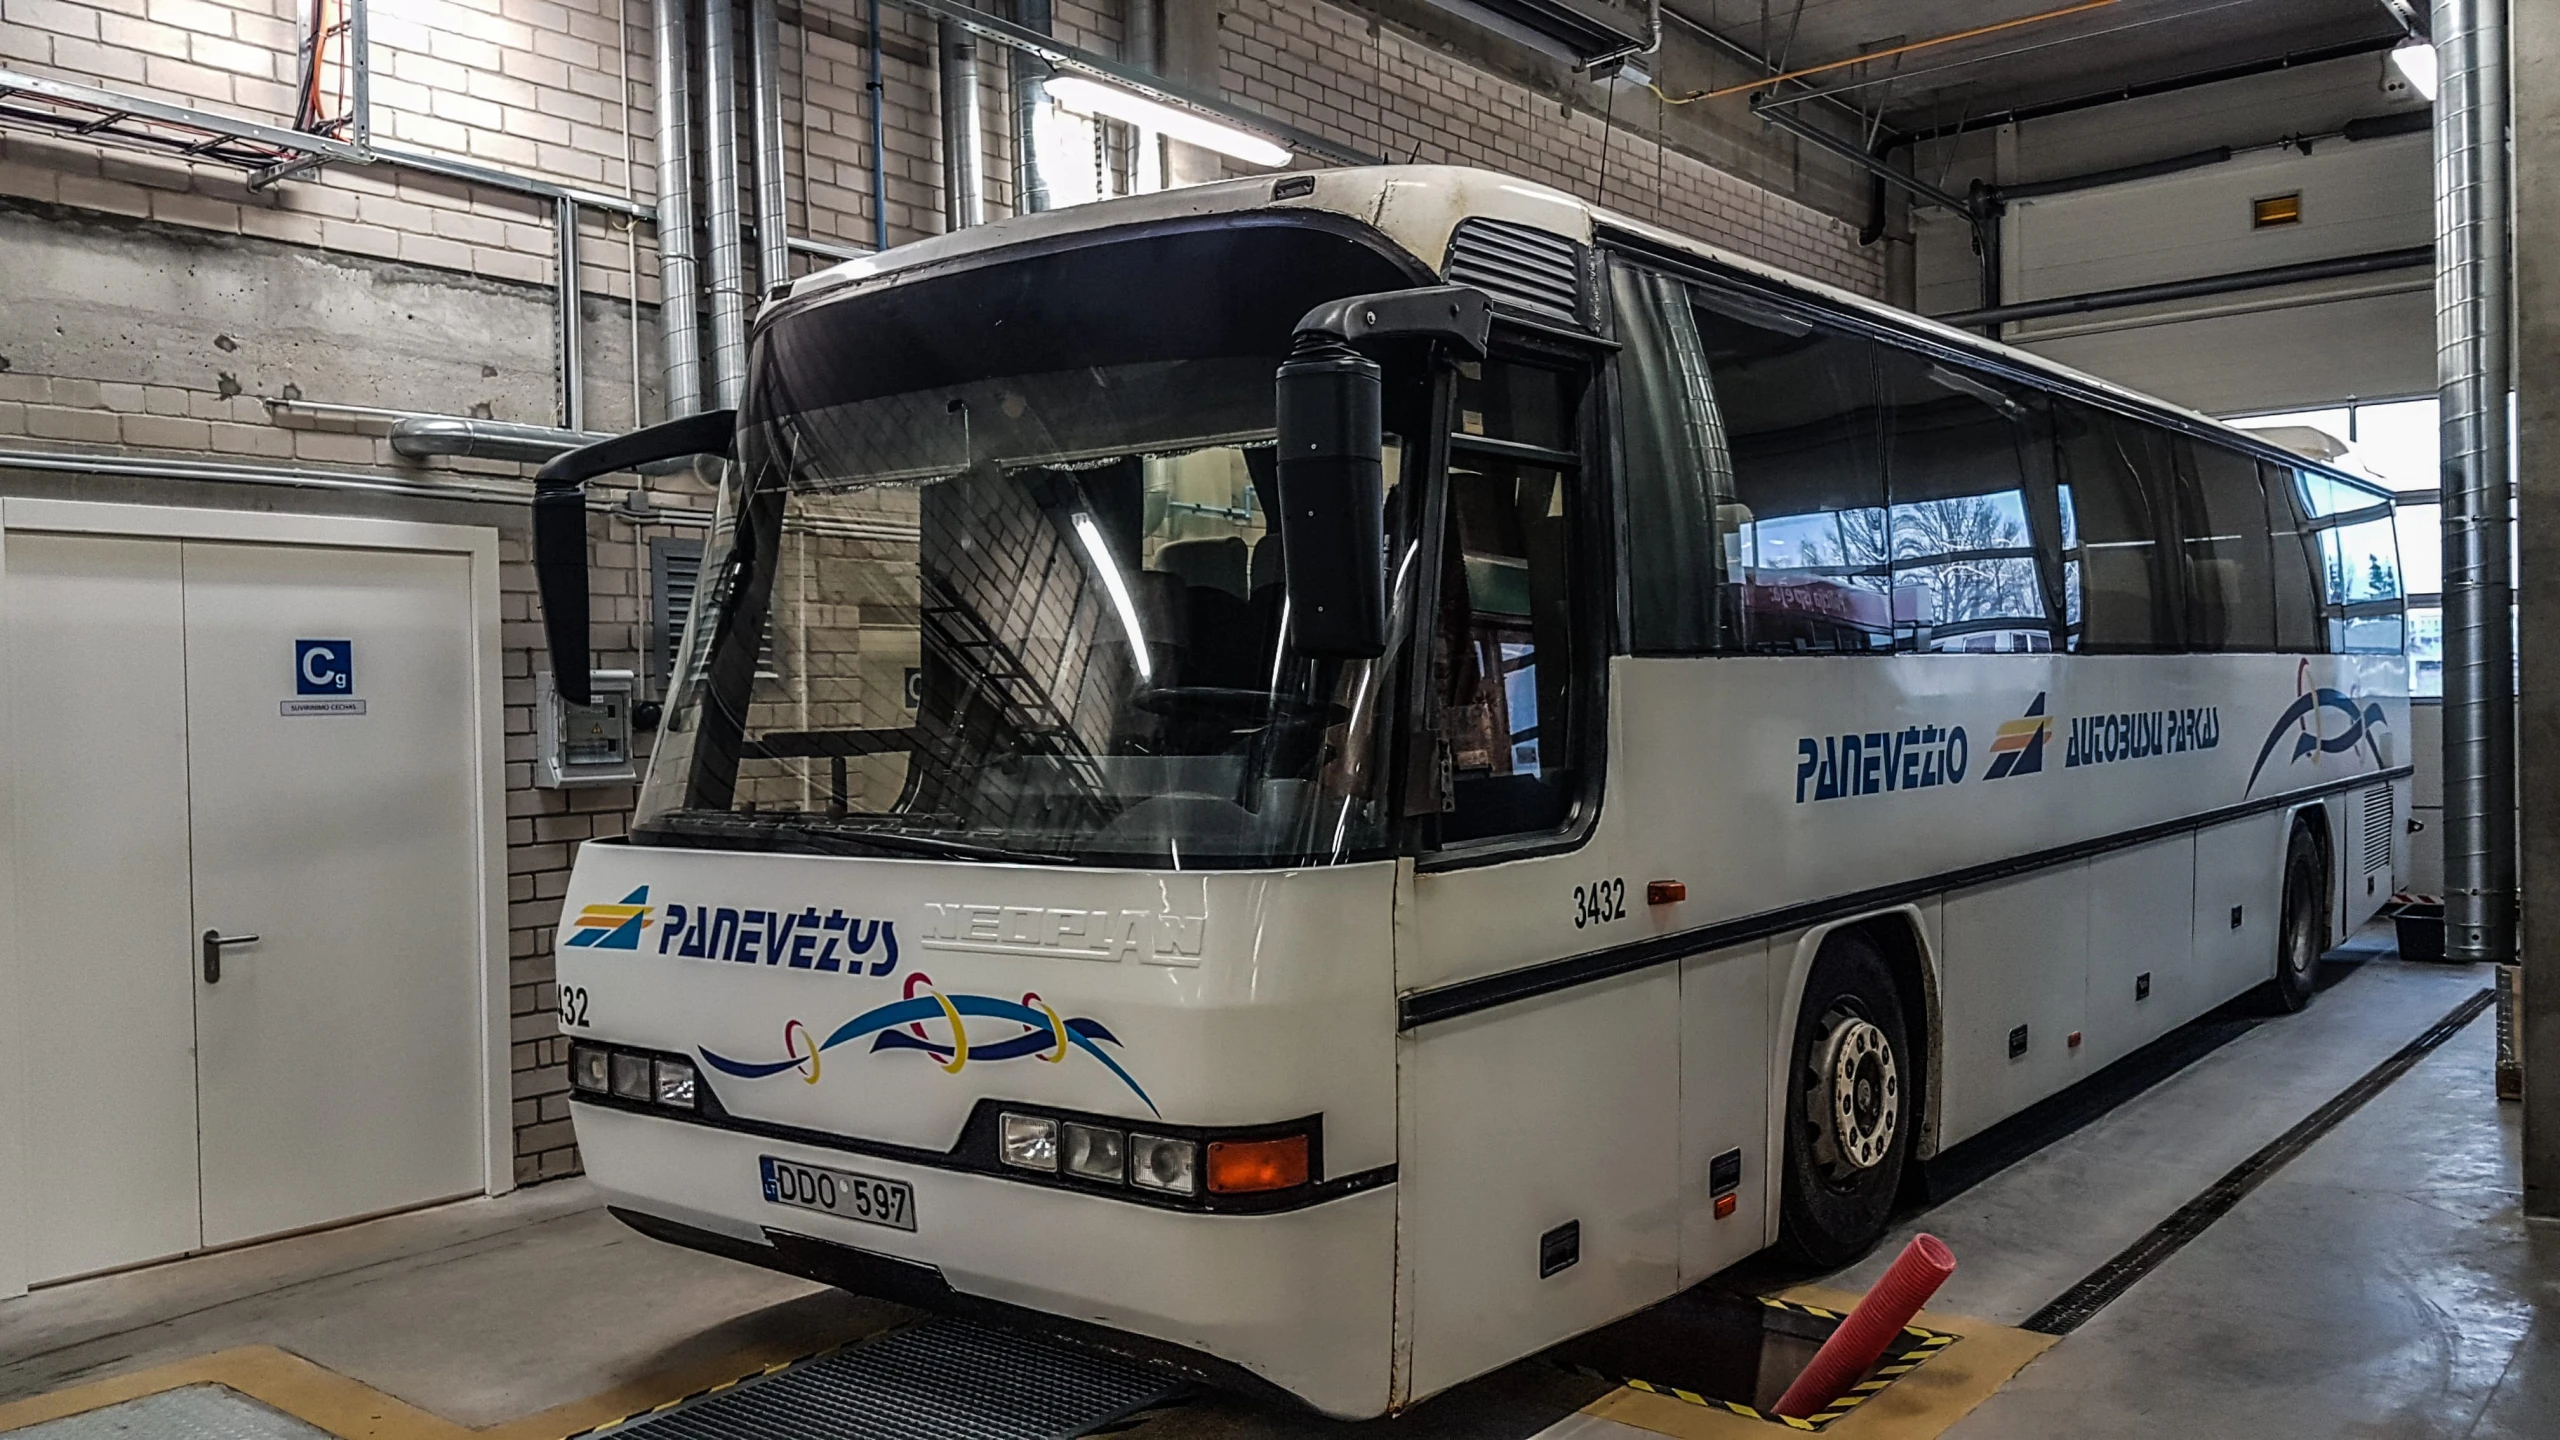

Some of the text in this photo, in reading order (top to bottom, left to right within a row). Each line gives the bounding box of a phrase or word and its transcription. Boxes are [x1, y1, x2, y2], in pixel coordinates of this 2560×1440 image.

[303, 646, 347, 689] Cg
[2167, 706, 2220, 754] PARKAS
[1573, 877, 1626, 929] 3432
[921, 902, 1208, 962] NEOPLAN
[765, 1182, 777, 1195] LT
[777, 1164, 906, 1223] DDO 597
